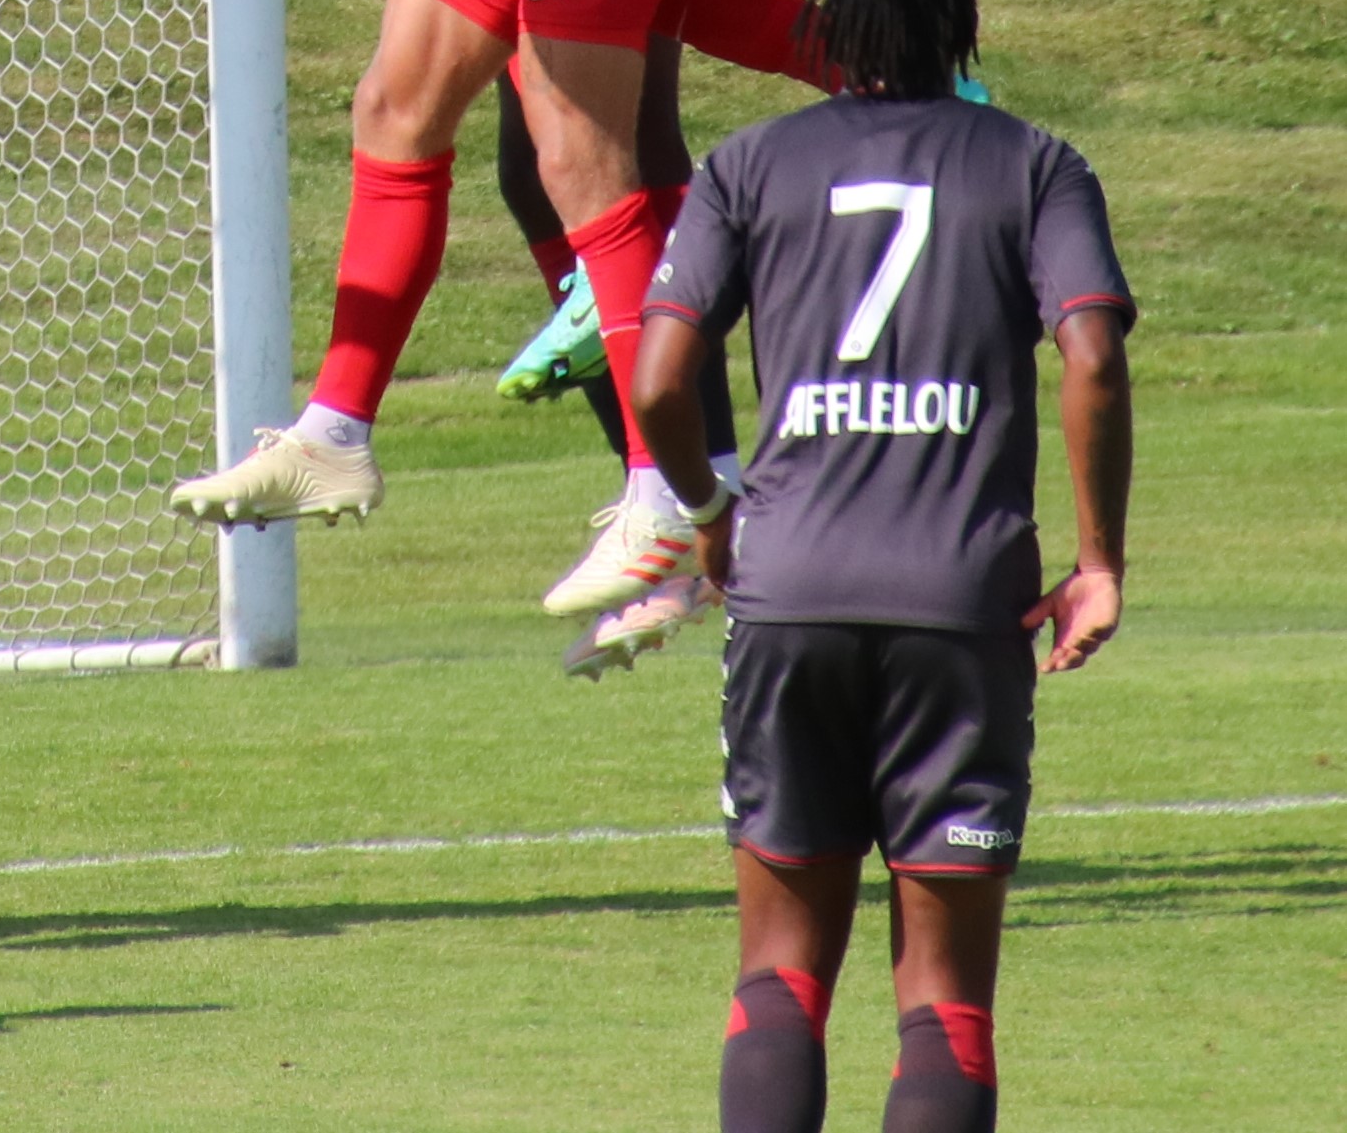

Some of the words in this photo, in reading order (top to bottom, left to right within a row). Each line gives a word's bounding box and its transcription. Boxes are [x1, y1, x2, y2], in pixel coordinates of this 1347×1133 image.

[830, 182, 934, 362] 7
[778, 380, 981, 441] AFFLELOU
[948, 826, 1014, 850] Kappa
